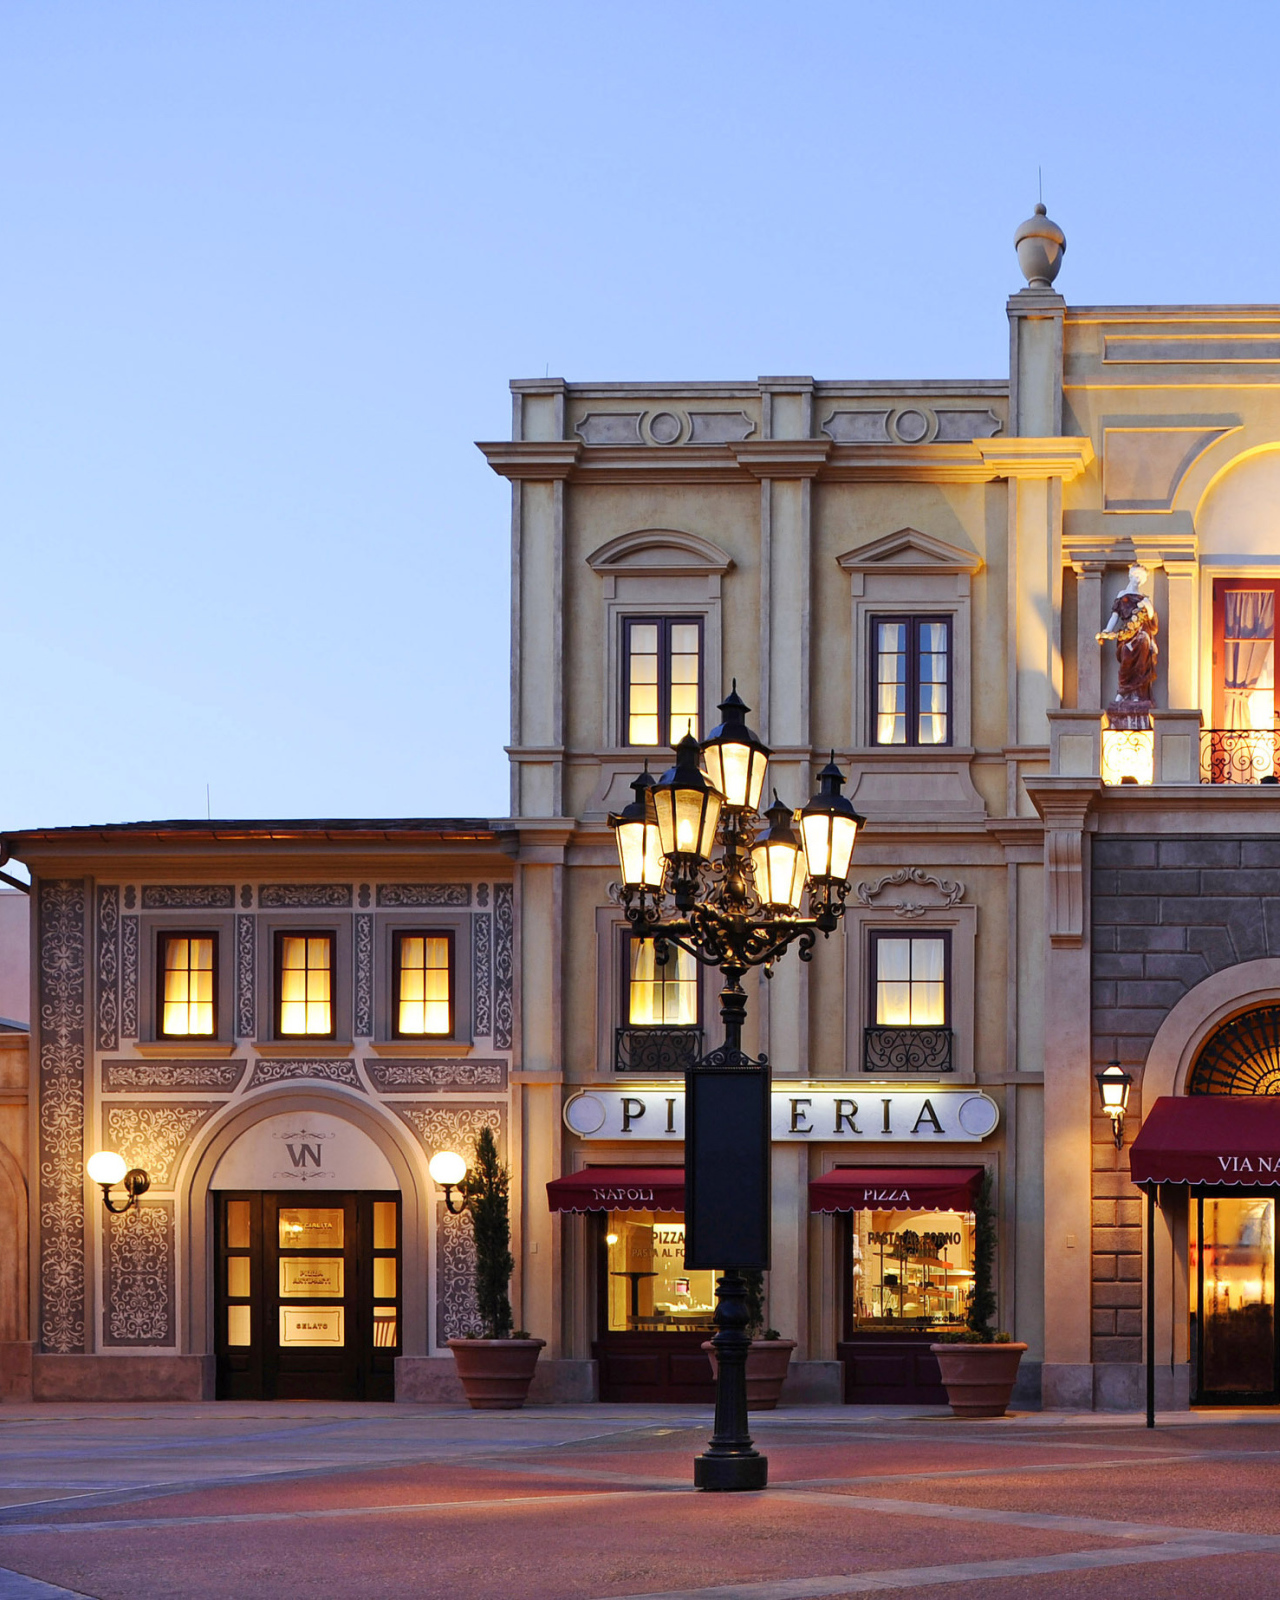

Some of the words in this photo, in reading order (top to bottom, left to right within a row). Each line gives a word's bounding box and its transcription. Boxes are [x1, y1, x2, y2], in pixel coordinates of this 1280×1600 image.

[620, 1098, 945, 1133] PIERIA
[285, 1143, 322, 1168] VN
[1217, 1156, 1254, 1172] VIA
[592, 1188, 654, 1201] NAPOLI
[863, 1189, 911, 1201] PIZZA
[652, 1231, 685, 1244] PIZZA
[867, 1232, 901, 1245] PASTA
[923, 1232, 961, 1245] FORNO
[632, 1248, 659, 1258] PASTA
[661, 1248, 673, 1258] AL
